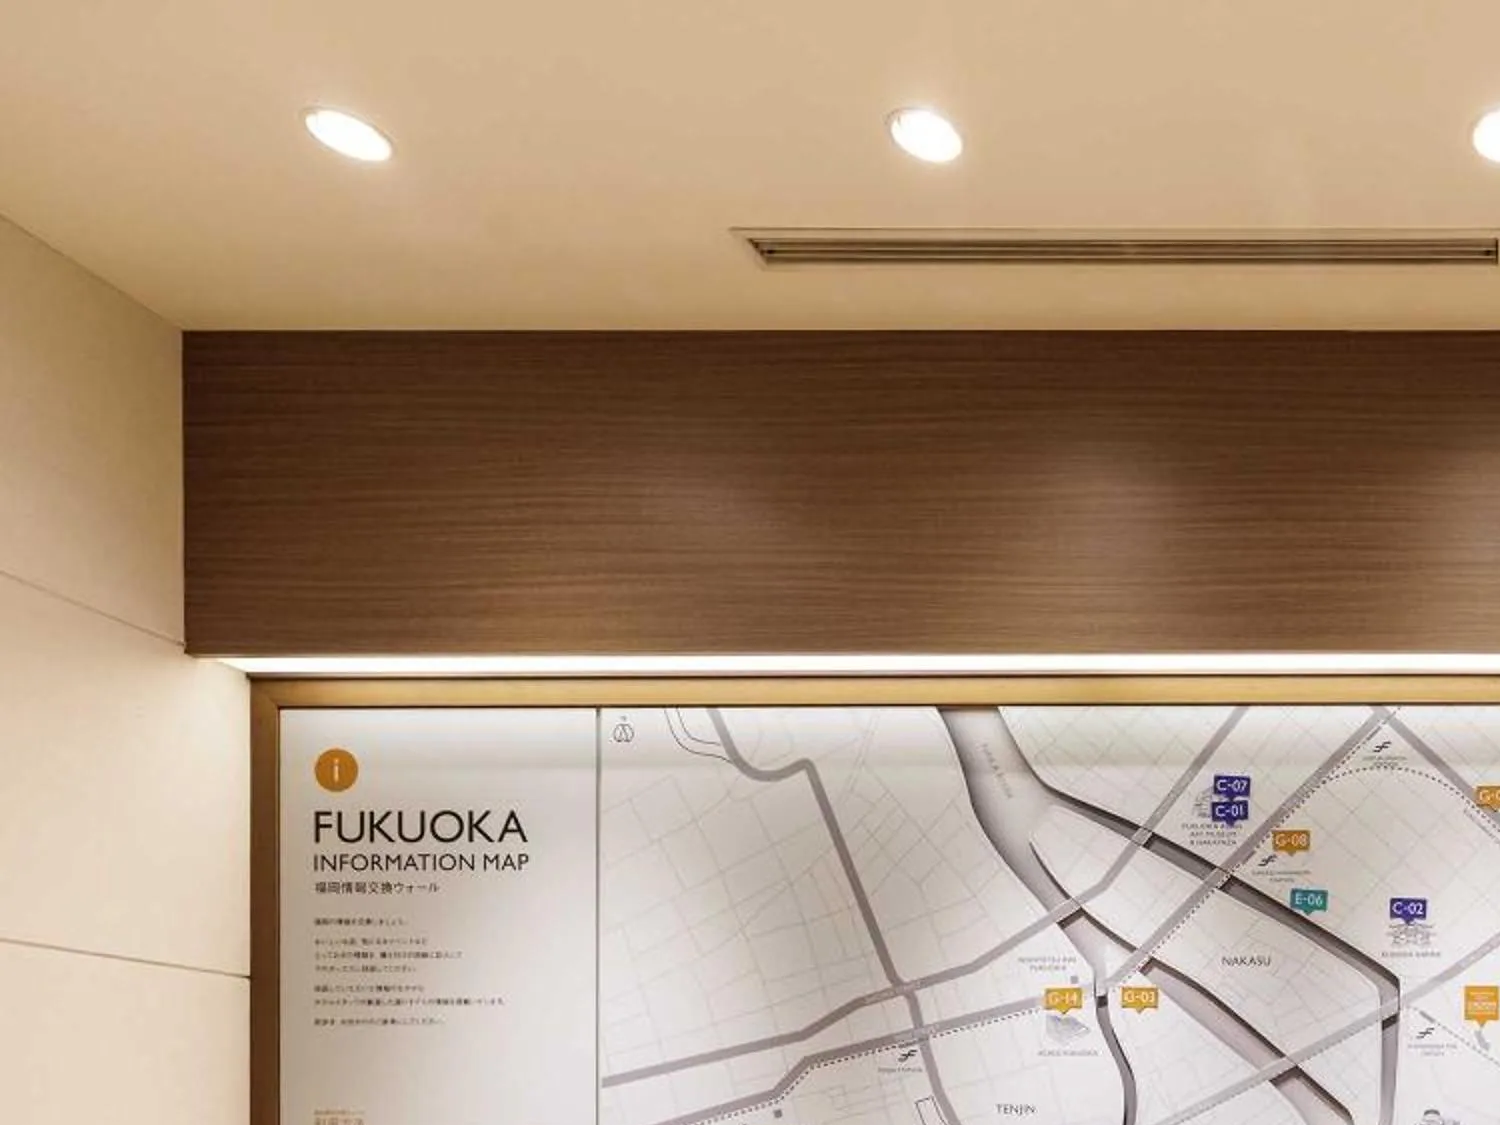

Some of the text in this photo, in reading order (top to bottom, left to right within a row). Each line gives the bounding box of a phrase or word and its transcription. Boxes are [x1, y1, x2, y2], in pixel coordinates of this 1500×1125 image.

[1215, 780, 1248, 792] C-07
[1215, 806, 1245, 817] C-01
[314, 810, 528, 843] FUKUOKA
[314, 854, 529, 872] INFORMATION MAP
[1294, 893, 1323, 906] E-06
[1392, 903, 1424, 915] C-02
[1222, 956, 1272, 966] NAKASU
[996, 1104, 1036, 1115] TENJIN
